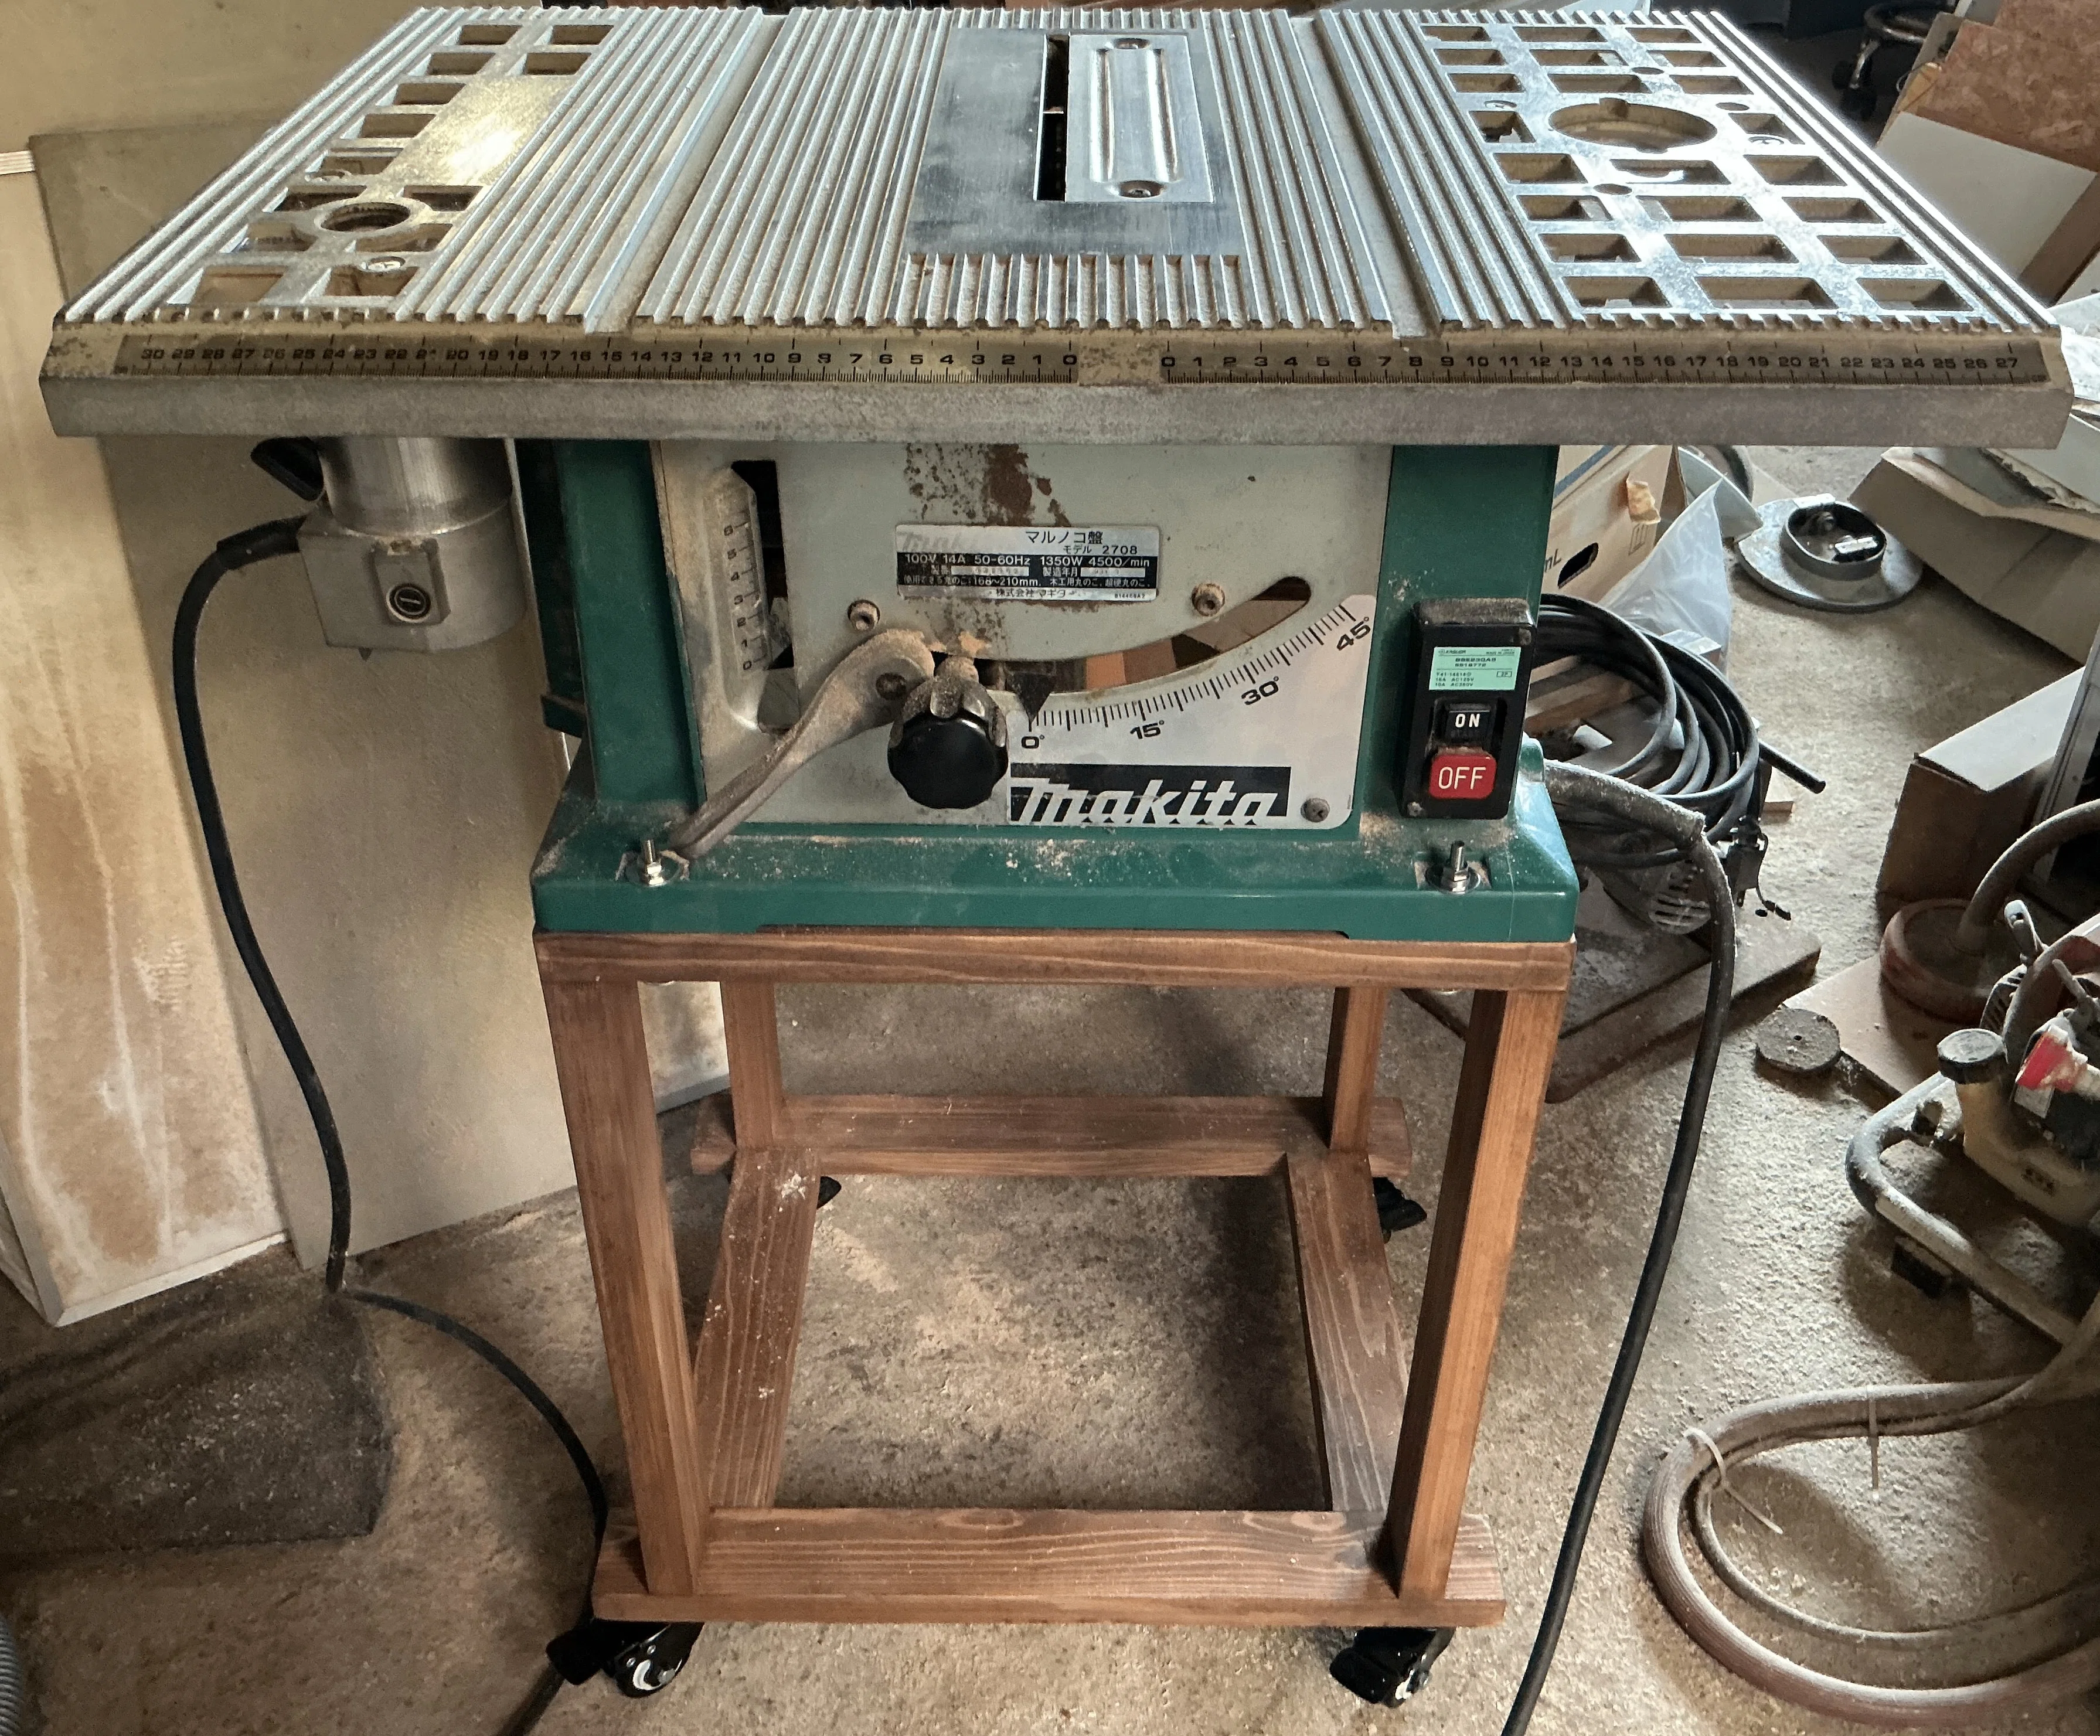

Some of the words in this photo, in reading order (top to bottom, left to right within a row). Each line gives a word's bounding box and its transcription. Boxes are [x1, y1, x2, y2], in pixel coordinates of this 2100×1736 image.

[141, 348, 164, 359] 30
[172, 349, 195, 359] 29
[202, 348, 224, 359] 28
[232, 348, 255, 359] 27
[293, 349, 315, 359] 25
[323, 349, 345, 359] 24
[352, 349, 377, 359] 23
[385, 349, 408, 359] 22
[416, 349, 436, 359] 2
[446, 349, 469, 360] 20
[478, 349, 498, 360] 19
[508, 350, 528, 360] 18
[540, 350, 561, 360] 17
[570, 350, 591, 361] 16
[601, 351, 622, 362] 15
[631, 350, 652, 362] 14
[661, 351, 682, 362] 13
[692, 351, 713, 362] 12
[722, 352, 741, 362] 11
[753, 353, 775, 363] 10
[788, 353, 802, 363] 9
[818, 353, 832, 363] 8
[850, 353, 863, 363] 7
[879, 354, 893, 364] 6
[910, 354, 923, 365] 5
[940, 355, 954, 365] 4
[971, 355, 985, 365] 3
[1002, 355, 1015, 365] 2
[1033, 355, 1042, 365] 1
[1063, 355, 1077, 365] 0
[1161, 356, 1175, 367] 0
[1193, 356, 1202, 366] 1
[1254, 356, 1268, 366] 3
[1284, 356, 1298, 366] 4
[1316, 356, 1330, 366] 5
[1347, 356, 1362, 367] 6
[1379, 356, 1391, 366] 7
[1408, 356, 1423, 367] 8
[1441, 356, 1455, 366] 9
[1466, 356, 1489, 367] 10
[1499, 356, 1519, 366] 11
[1530, 356, 1551, 367] 12
[1560, 356, 1582, 367] 13
[1591, 356, 1613, 366] 14
[1622, 356, 1645, 366] 15
[1653, 356, 1676, 367] 16
[1685, 356, 1706, 367] 17
[1716, 356, 1738, 367] 18
[1747, 356, 1769, 367] 19
[1778, 356, 1801, 367] 20
[1809, 356, 1829, 367] 21
[1840, 356, 1863, 368] 22
[1870, 356, 1895, 369] 23
[1902, 357, 1925, 369] 24
[1933, 358, 1956, 369] 25
[1964, 358, 1988, 369] 26
[1996, 358, 2018, 369] 27
[724, 525, 733, 536] 6
[1026, 531, 1103, 544] マルノコ盤
[727, 549, 737, 560] 5
[1063, 545, 1092, 554] モデル
[1102, 545, 1138, 554] 2708
[905, 554, 937, 563] 100V
[943, 554, 966, 564] 14A
[974, 555, 1030, 566] 50-60Hz
[1041, 556, 1083, 566] 1350W
[1088, 557, 1149, 567] 4500/min
[731, 571, 740, 581] 4
[734, 594, 743, 605] 3
[737, 617, 746, 627] 2
[1336, 617, 1371, 651] 45°
[741, 639, 747, 648] 1
[743, 661, 751, 670] 0
[1240, 676, 1279, 706] 30°
[1455, 713, 1480, 727] ON
[1129, 720, 1165, 740] 15°
[1020, 734, 1044, 749] 0°
[1438, 766, 1486, 790] OFF
